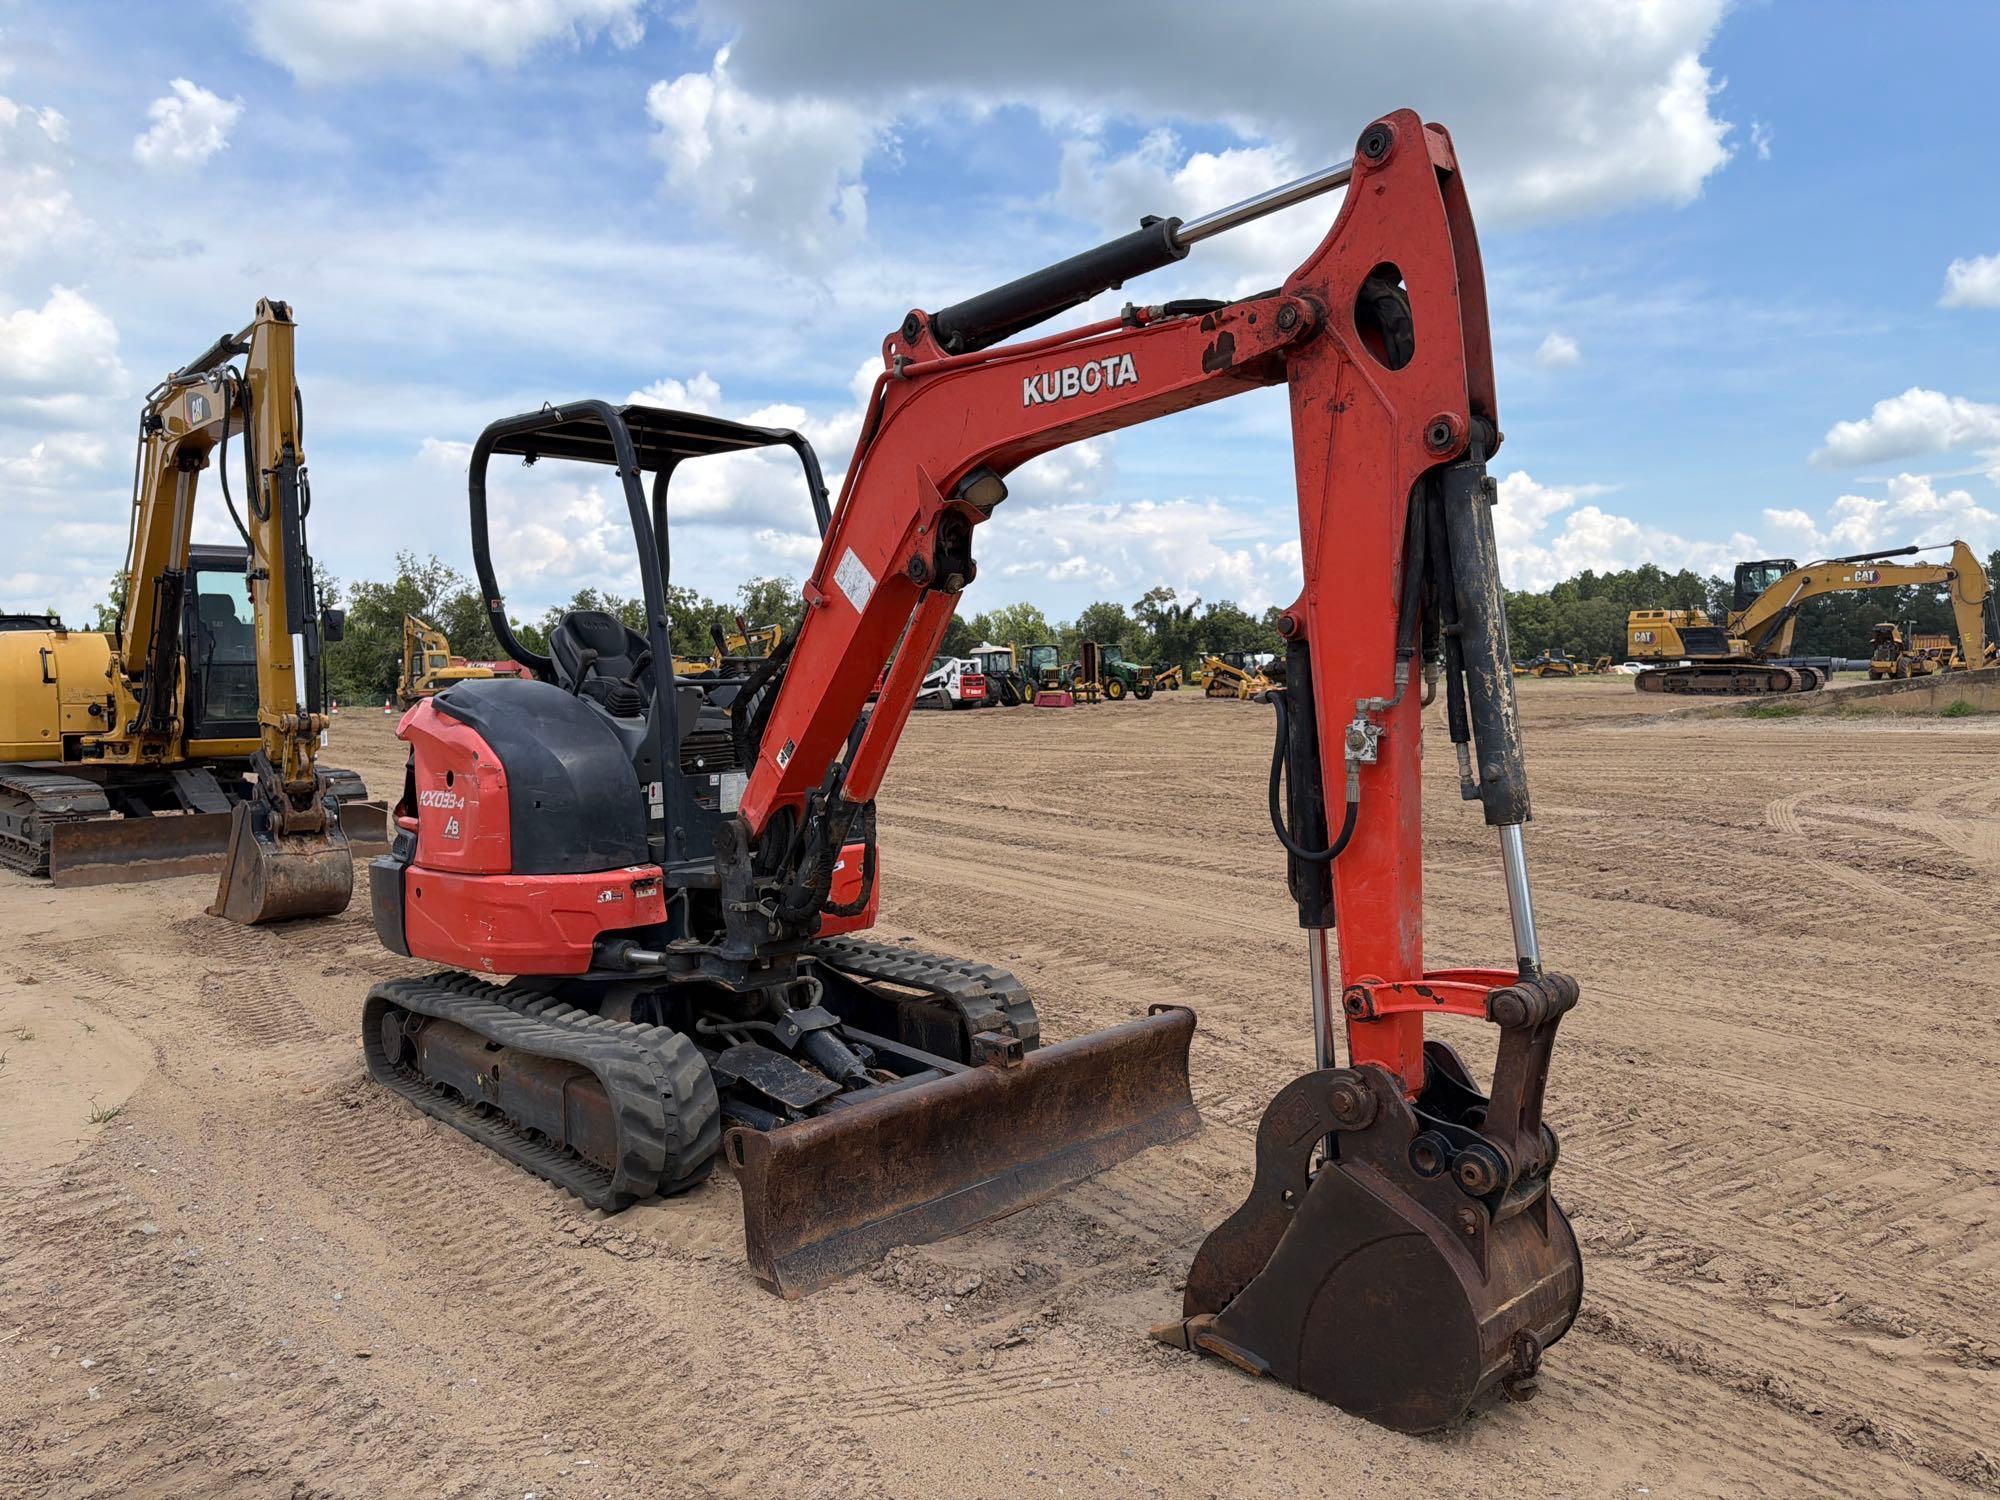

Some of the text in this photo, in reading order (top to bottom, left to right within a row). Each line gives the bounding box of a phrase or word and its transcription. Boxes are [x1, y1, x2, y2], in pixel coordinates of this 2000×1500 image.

[1023, 353, 1138, 407] KUBOTA
[192, 397, 203, 424] CAT
[1855, 570, 1875, 582] CAT
[1634, 631, 1651, 642] CAT
[420, 790, 465, 809] KX033-4
